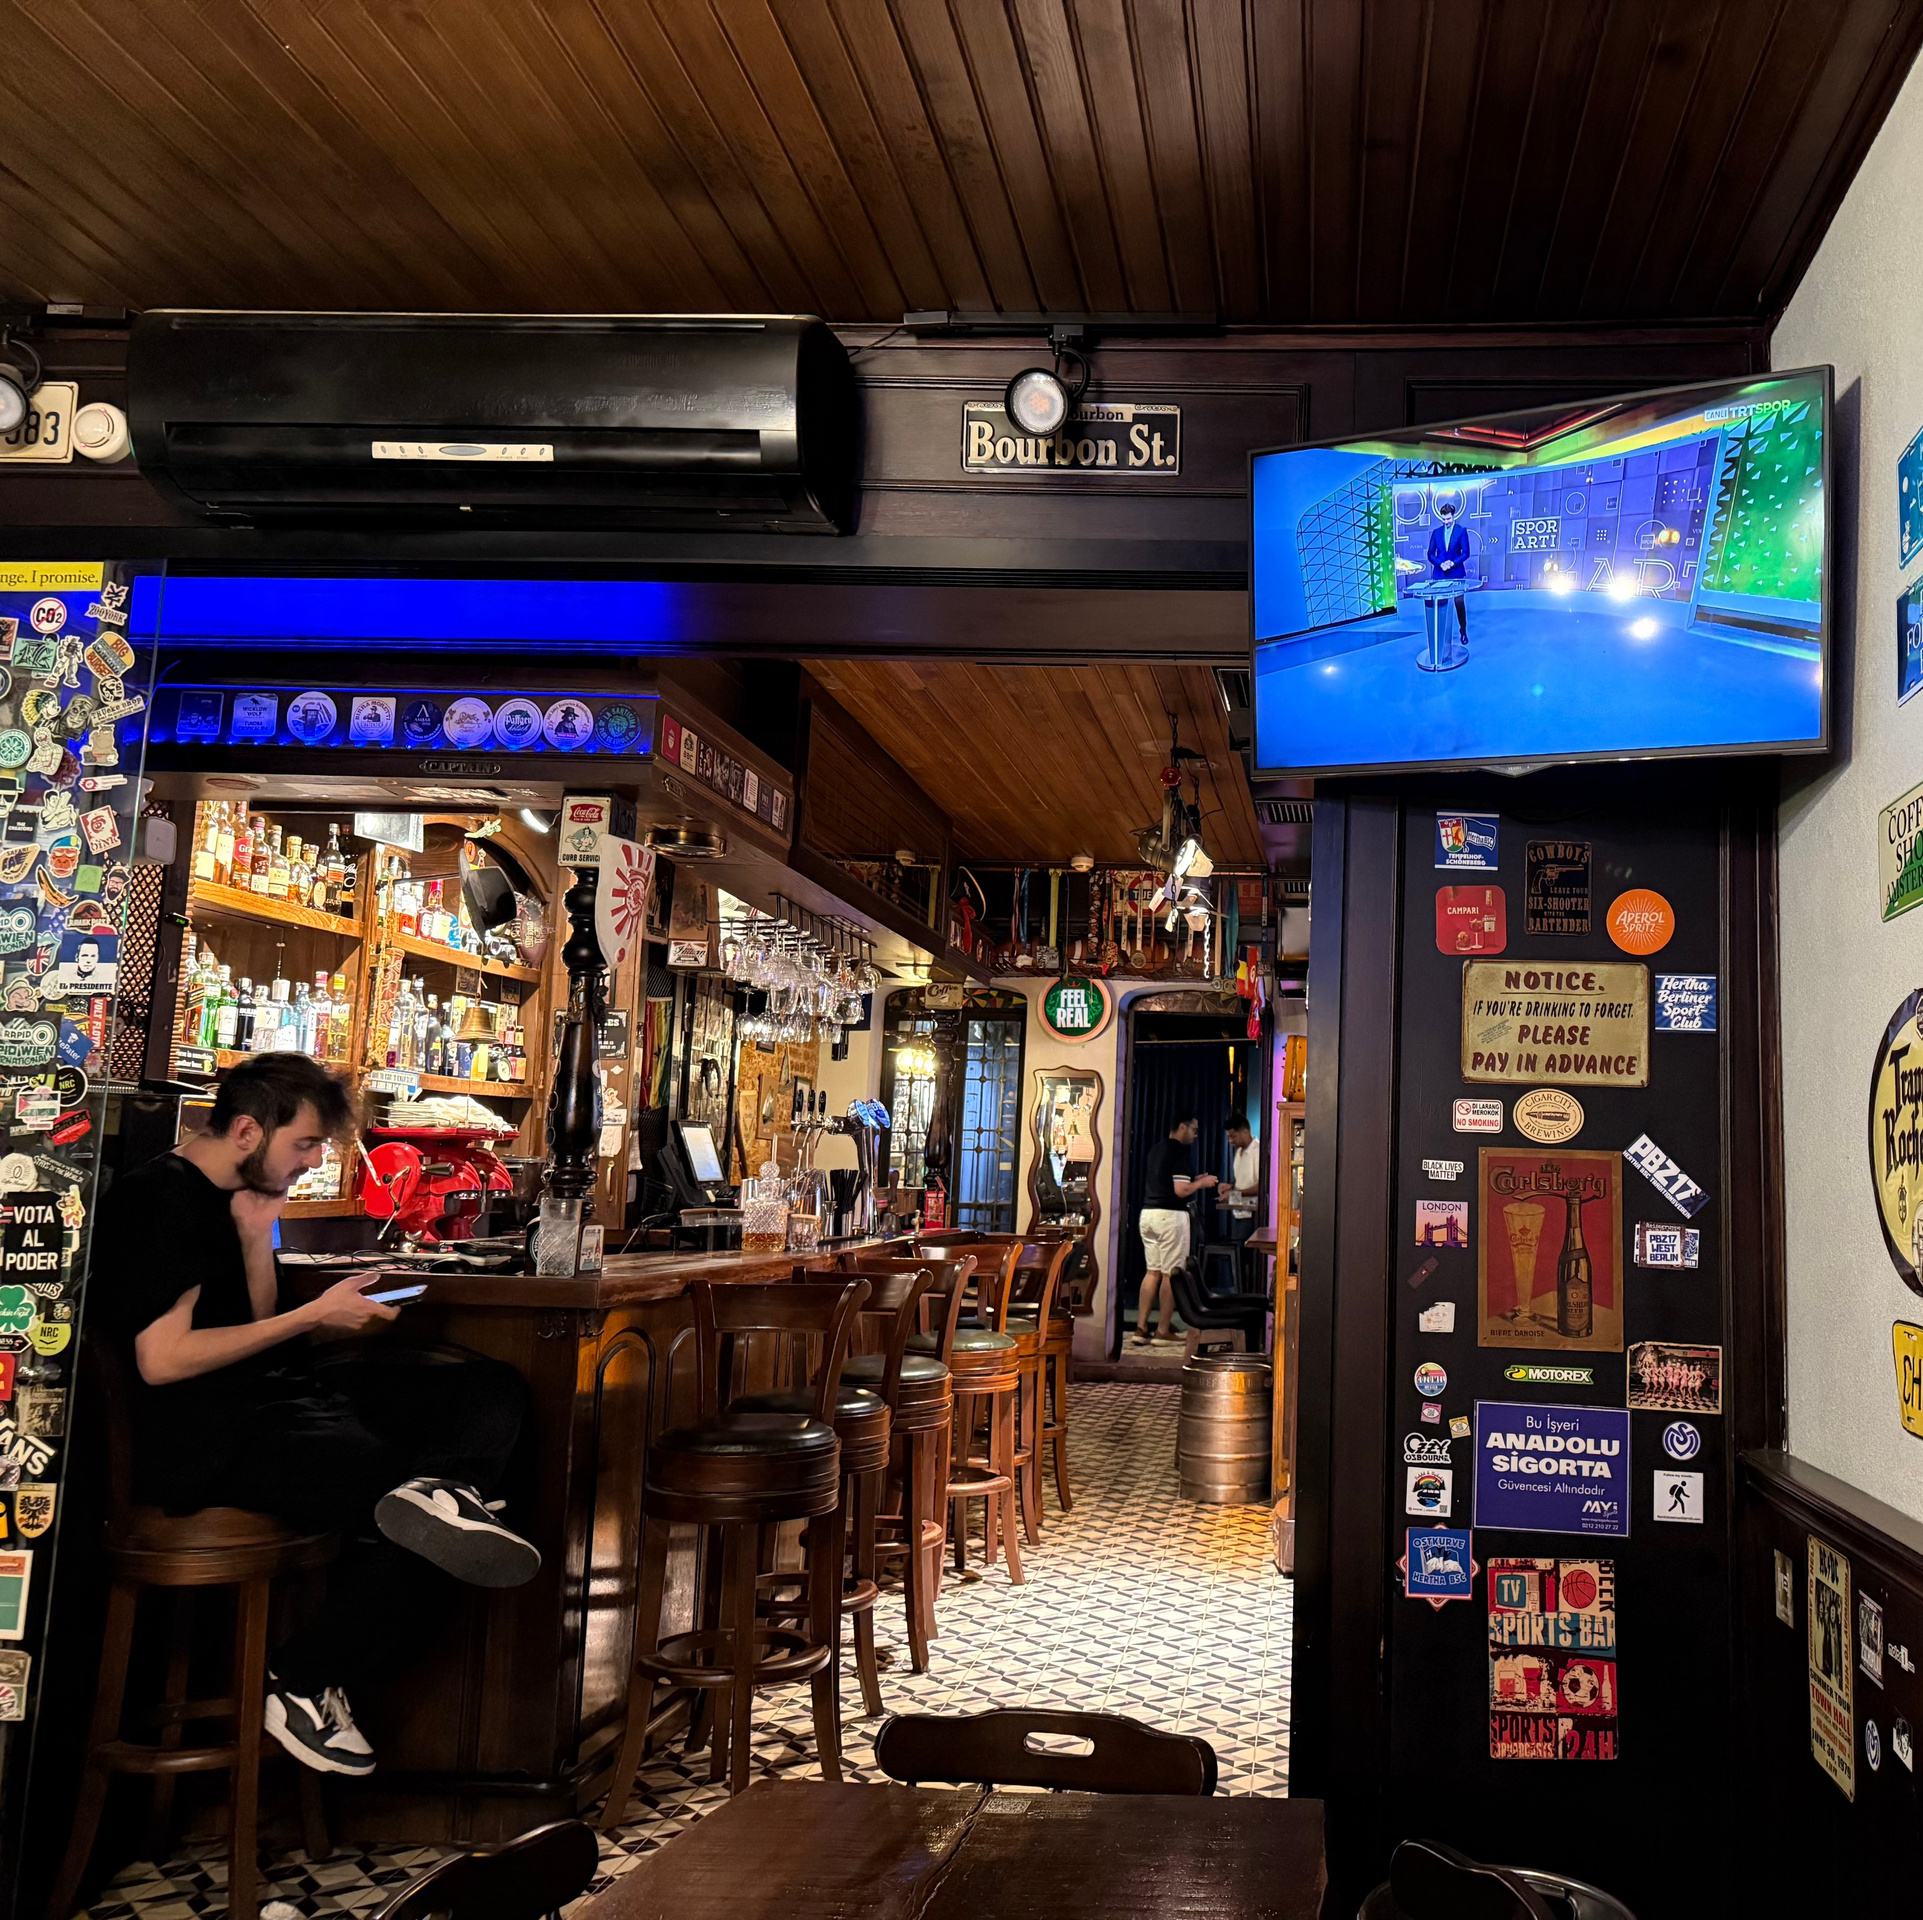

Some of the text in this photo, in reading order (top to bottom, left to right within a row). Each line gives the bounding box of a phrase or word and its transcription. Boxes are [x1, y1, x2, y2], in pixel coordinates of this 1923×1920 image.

[1069, 408, 1125, 421] ourbon
[1706, 410, 1728, 421] CANLI
[5, 411, 60, 446] 83
[968, 421, 1176, 467] Bourbon St.
[1515, 519, 1558, 536] SPOR
[1514, 535, 1558, 551] ARTI
[32, 570, 37, 583] I
[40, 570, 98, 586] promise.
[110, 637, 129, 658] BIG
[355, 701, 371, 721] BIRRA
[430, 762, 491, 773] CAPTAIN
[562, 854, 577, 862] CURB
[1528, 845, 1590, 863] COWBOYS
[1447, 907, 1479, 915] CAMPARI
[1528, 897, 1590, 911] SIX-SHOOTER
[1528, 918, 1590, 932] BARTENDER
[1616, 911, 1664, 925] APEROL
[1623, 923, 1655, 933] SPRITZ
[69, 982, 113, 990] PRESIDENTE
[1504, 970, 1605, 992] NOTICE.
[1661, 977, 1709, 992] Hertha
[927, 984, 959, 998] Coffee
[1060, 989, 1088, 1008] FEEL
[1657, 990, 1713, 1006] Berliner
[93, 999, 104, 1018] VOLT
[1473, 1000, 1634, 1019] IF YOU'RE DRINKING TO FORGET.
[1662, 1003, 1709, 1020] Sport-
[1056, 1007, 1091, 1028] REAL
[1671, 1015, 1702, 1029] Club
[4, 1030, 32, 1038] RAPID
[1517, 1024, 1591, 1046] PLEASE
[21, 1046, 54, 1056] WIEN
[1471, 1052, 1638, 1076] PAY IN ADVANCE
[60, 1080, 76, 1090] NRC
[1525, 1093, 1576, 1110] CIGAR CITY
[1457, 1118, 1499, 1128] NO SMOKING
[1523, 1121, 1573, 1139] BREWING
[1423, 1161, 1463, 1172] BLACK LIVES
[1428, 1170, 1455, 1179] MATTER
[1627, 1133, 1702, 1201] PBZ17
[1489, 1165, 1607, 1198] Carlsberg
[14, 1206, 55, 1224] VOTA
[1422, 1202, 1462, 1212] LONDON
[22, 1230, 44, 1247] AL
[1649, 1235, 1677, 1243] PBZ17
[1651, 1244, 1676, 1252] WEST
[5, 1253, 58, 1271] PODER
[1649, 1253, 1679, 1262] BERLIN
[40, 1326, 59, 1337] NRC
[1514, 1329, 1545, 1338] DANOISE
[1528, 1369, 1591, 1383] MOTOREX
[1526, 1413, 1580, 1433] Bu İşyeri
[1486, 1432, 1620, 1456] ANADOLU
[1405, 1454, 1451, 1462] OSBOURNE
[1492, 1451, 1612, 1478] SİGORTA
[1498, 1479, 1606, 1496] Güvencesi Altındadır
[1413, 1537, 1466, 1549] OSTKURVE
[1412, 1571, 1467, 1585] HERTHA BSC
[1501, 1579, 1521, 1603] TV
[1489, 1612, 1572, 1647] SPORTS
[1810, 1668, 1851, 1714] SUMMER TOUR
[1811, 1683, 1832, 1717] TOWN
[1833, 1706, 1851, 1737] HALL
[1490, 1715, 1556, 1743] SPORTS
[1566, 1730, 1614, 1760] 24H
[1811, 1728, 1826, 1752] JUNE
[1837, 1755, 1852, 1780] 1979
